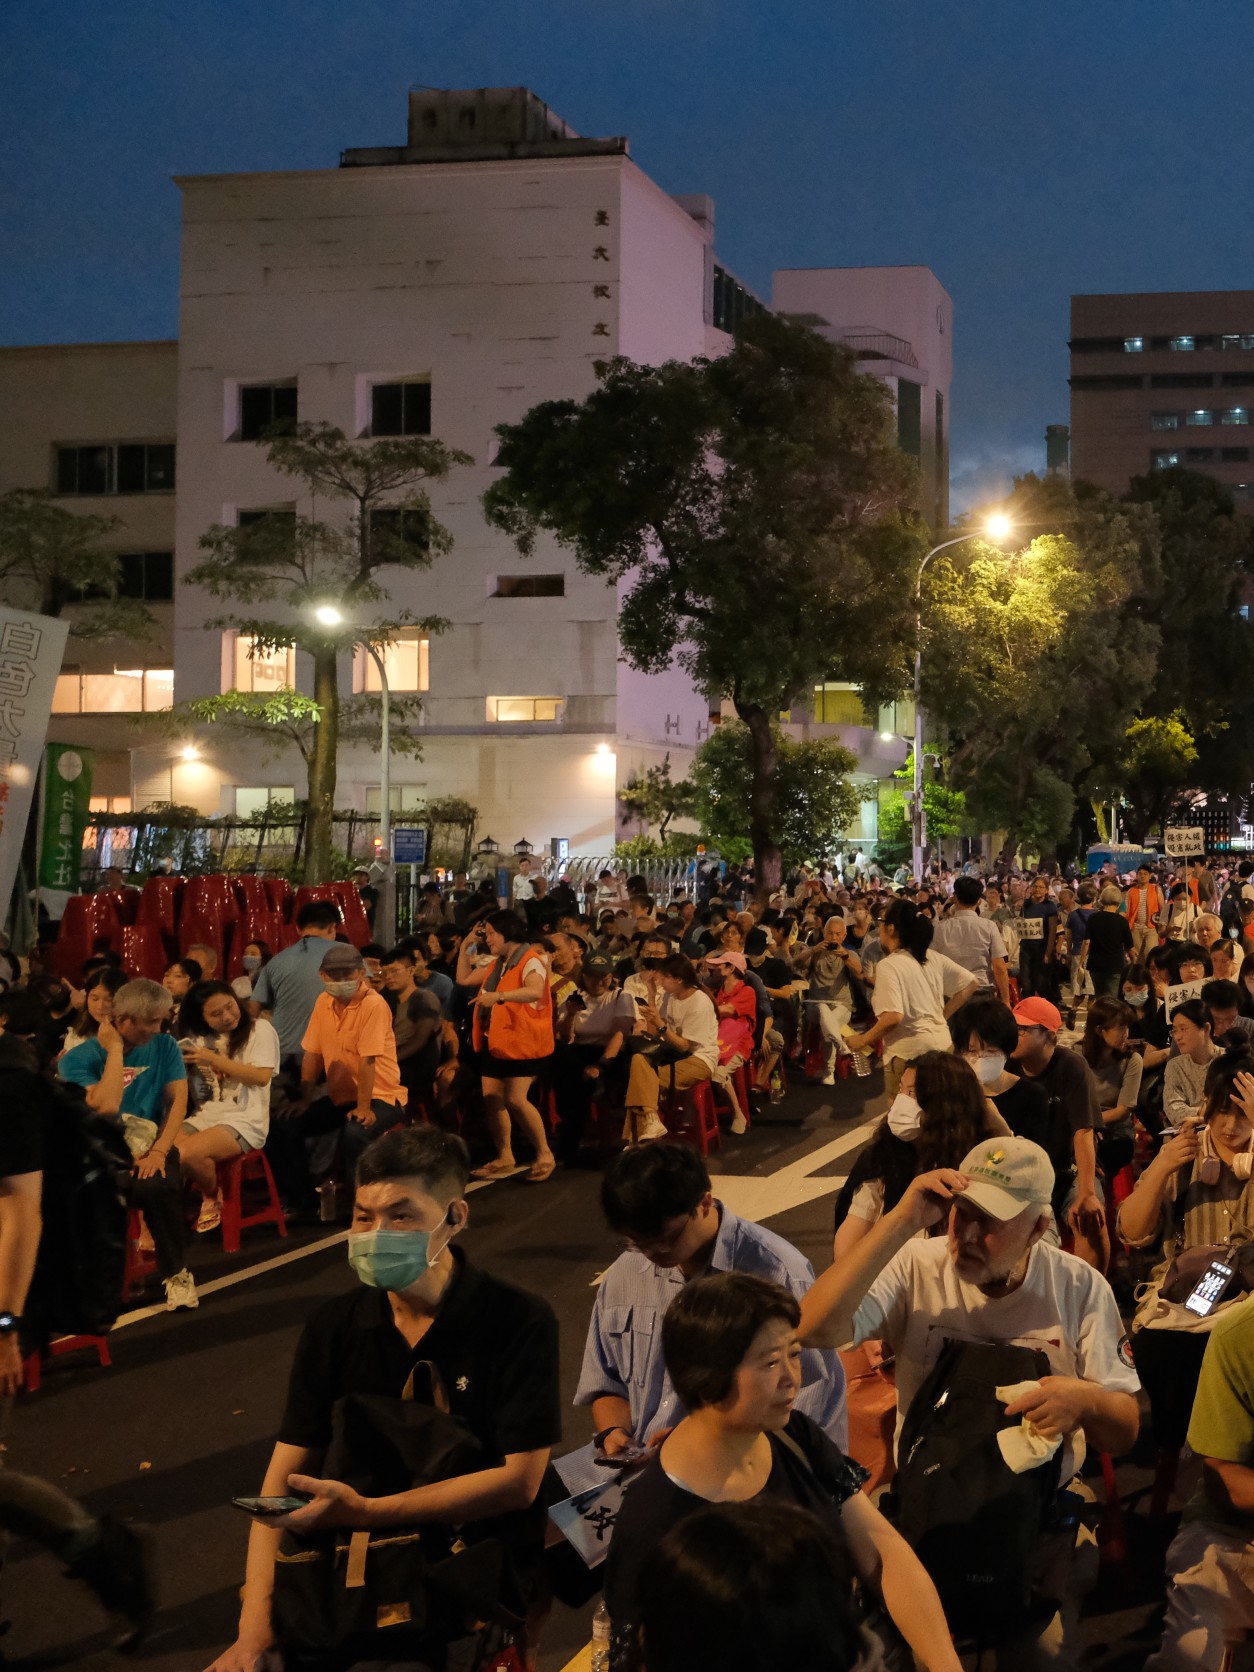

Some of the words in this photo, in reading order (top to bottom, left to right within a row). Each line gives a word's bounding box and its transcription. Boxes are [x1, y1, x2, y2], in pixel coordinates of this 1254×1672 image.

[1167, 832, 1201, 842] 侵害人權
[1169, 988, 1201, 1003] 侵害人
